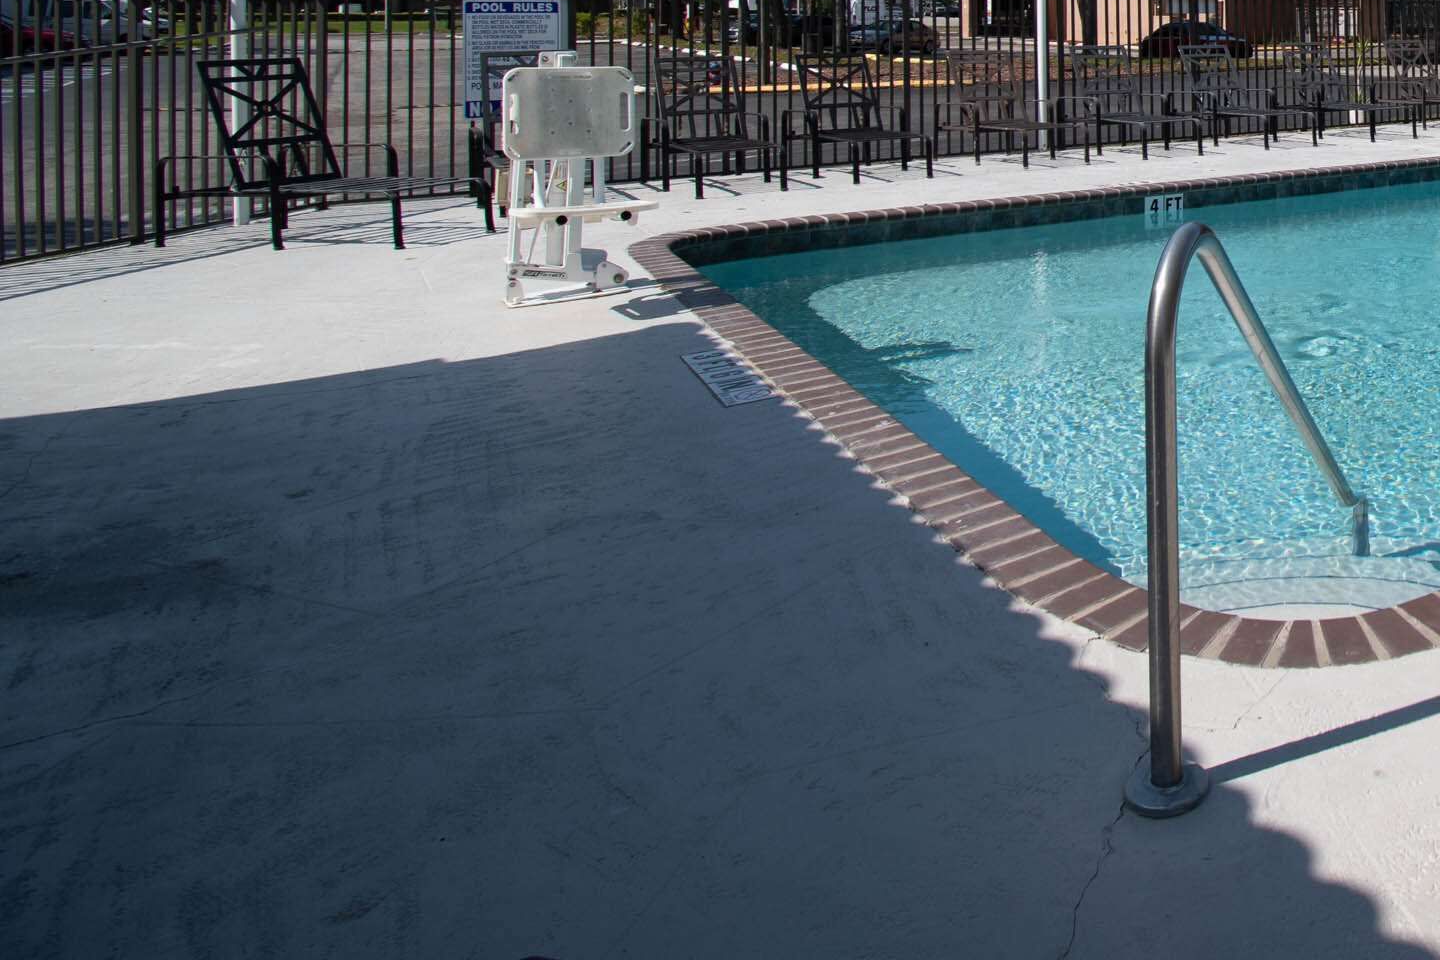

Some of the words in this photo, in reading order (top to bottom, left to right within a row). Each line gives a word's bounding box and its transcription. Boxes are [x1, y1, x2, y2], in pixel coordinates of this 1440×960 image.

[472, 3, 506, 11] POOL
[513, 3, 553, 11] RULES
[1151, 199, 1159, 212] 4
[1165, 196, 1182, 211] FT
